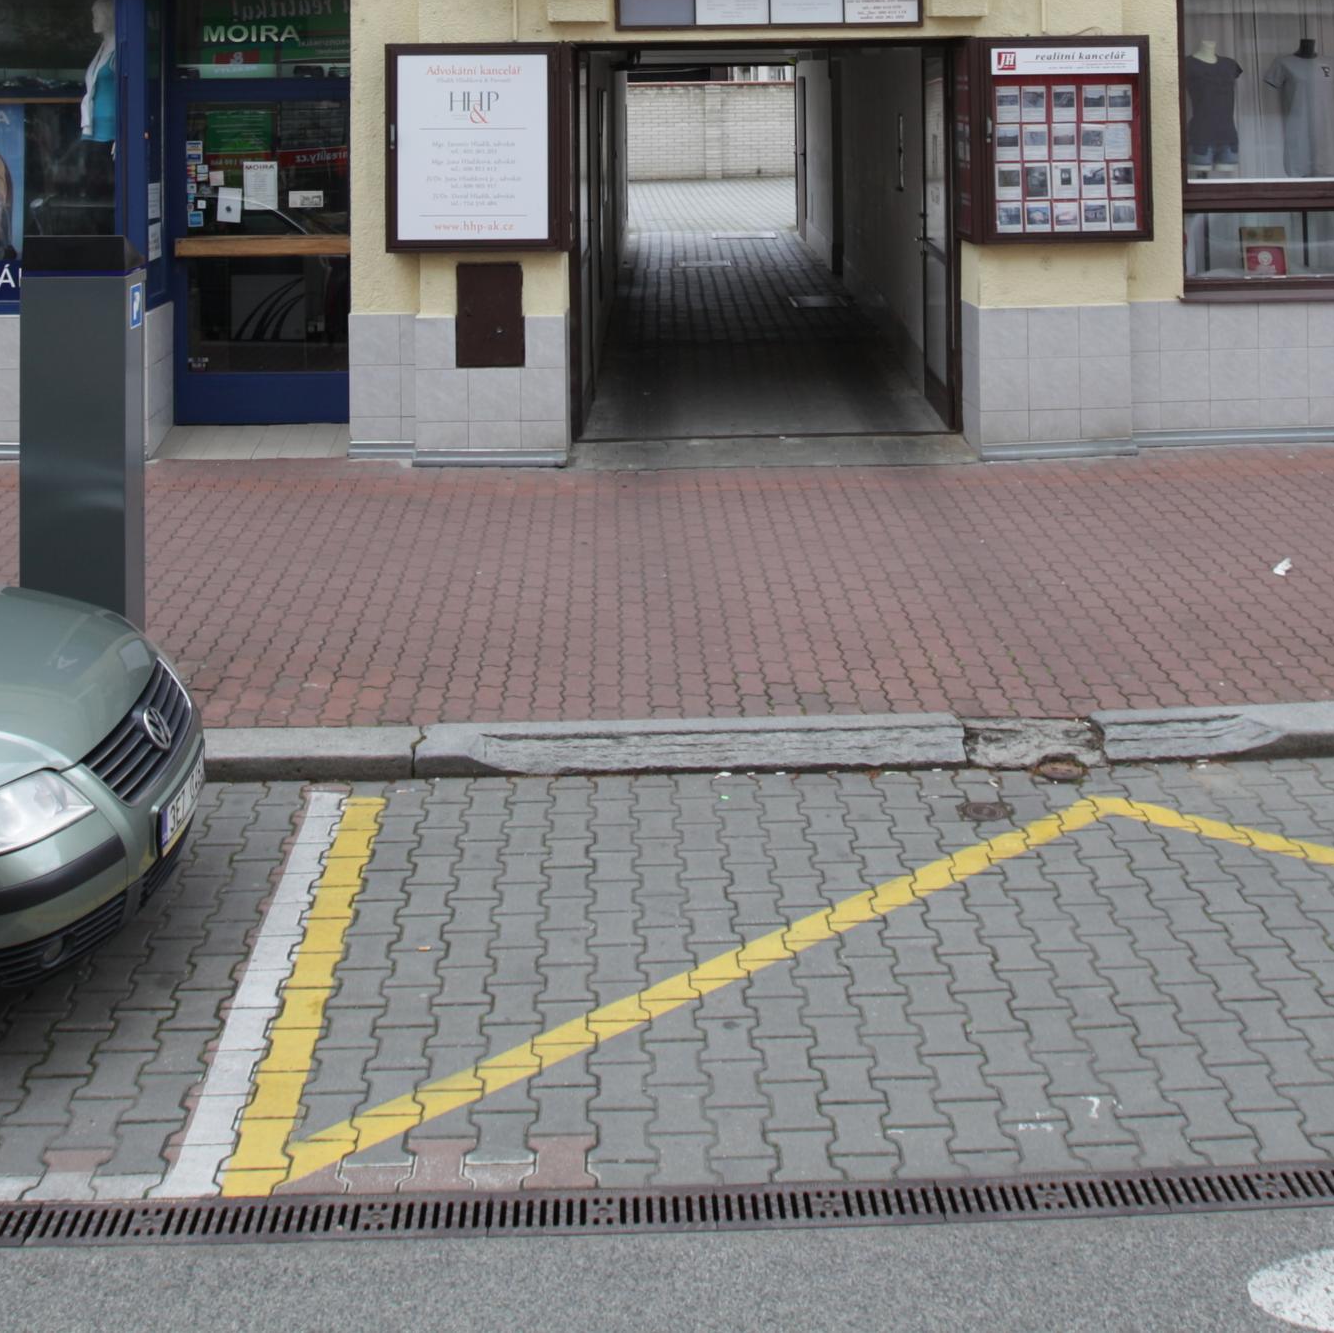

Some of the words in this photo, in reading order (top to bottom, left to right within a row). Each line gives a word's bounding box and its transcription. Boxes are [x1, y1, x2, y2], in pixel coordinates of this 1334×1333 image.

[203, 25, 300, 43] MOIRA
[1035, 52, 1075, 61] realitní
[1078, 50, 1127, 60] kancelář
[426, 65, 476, 76] Advokátní
[479, 65, 521, 76] kancelář
[434, 221, 515, 234] www.hhp-ak.cz
